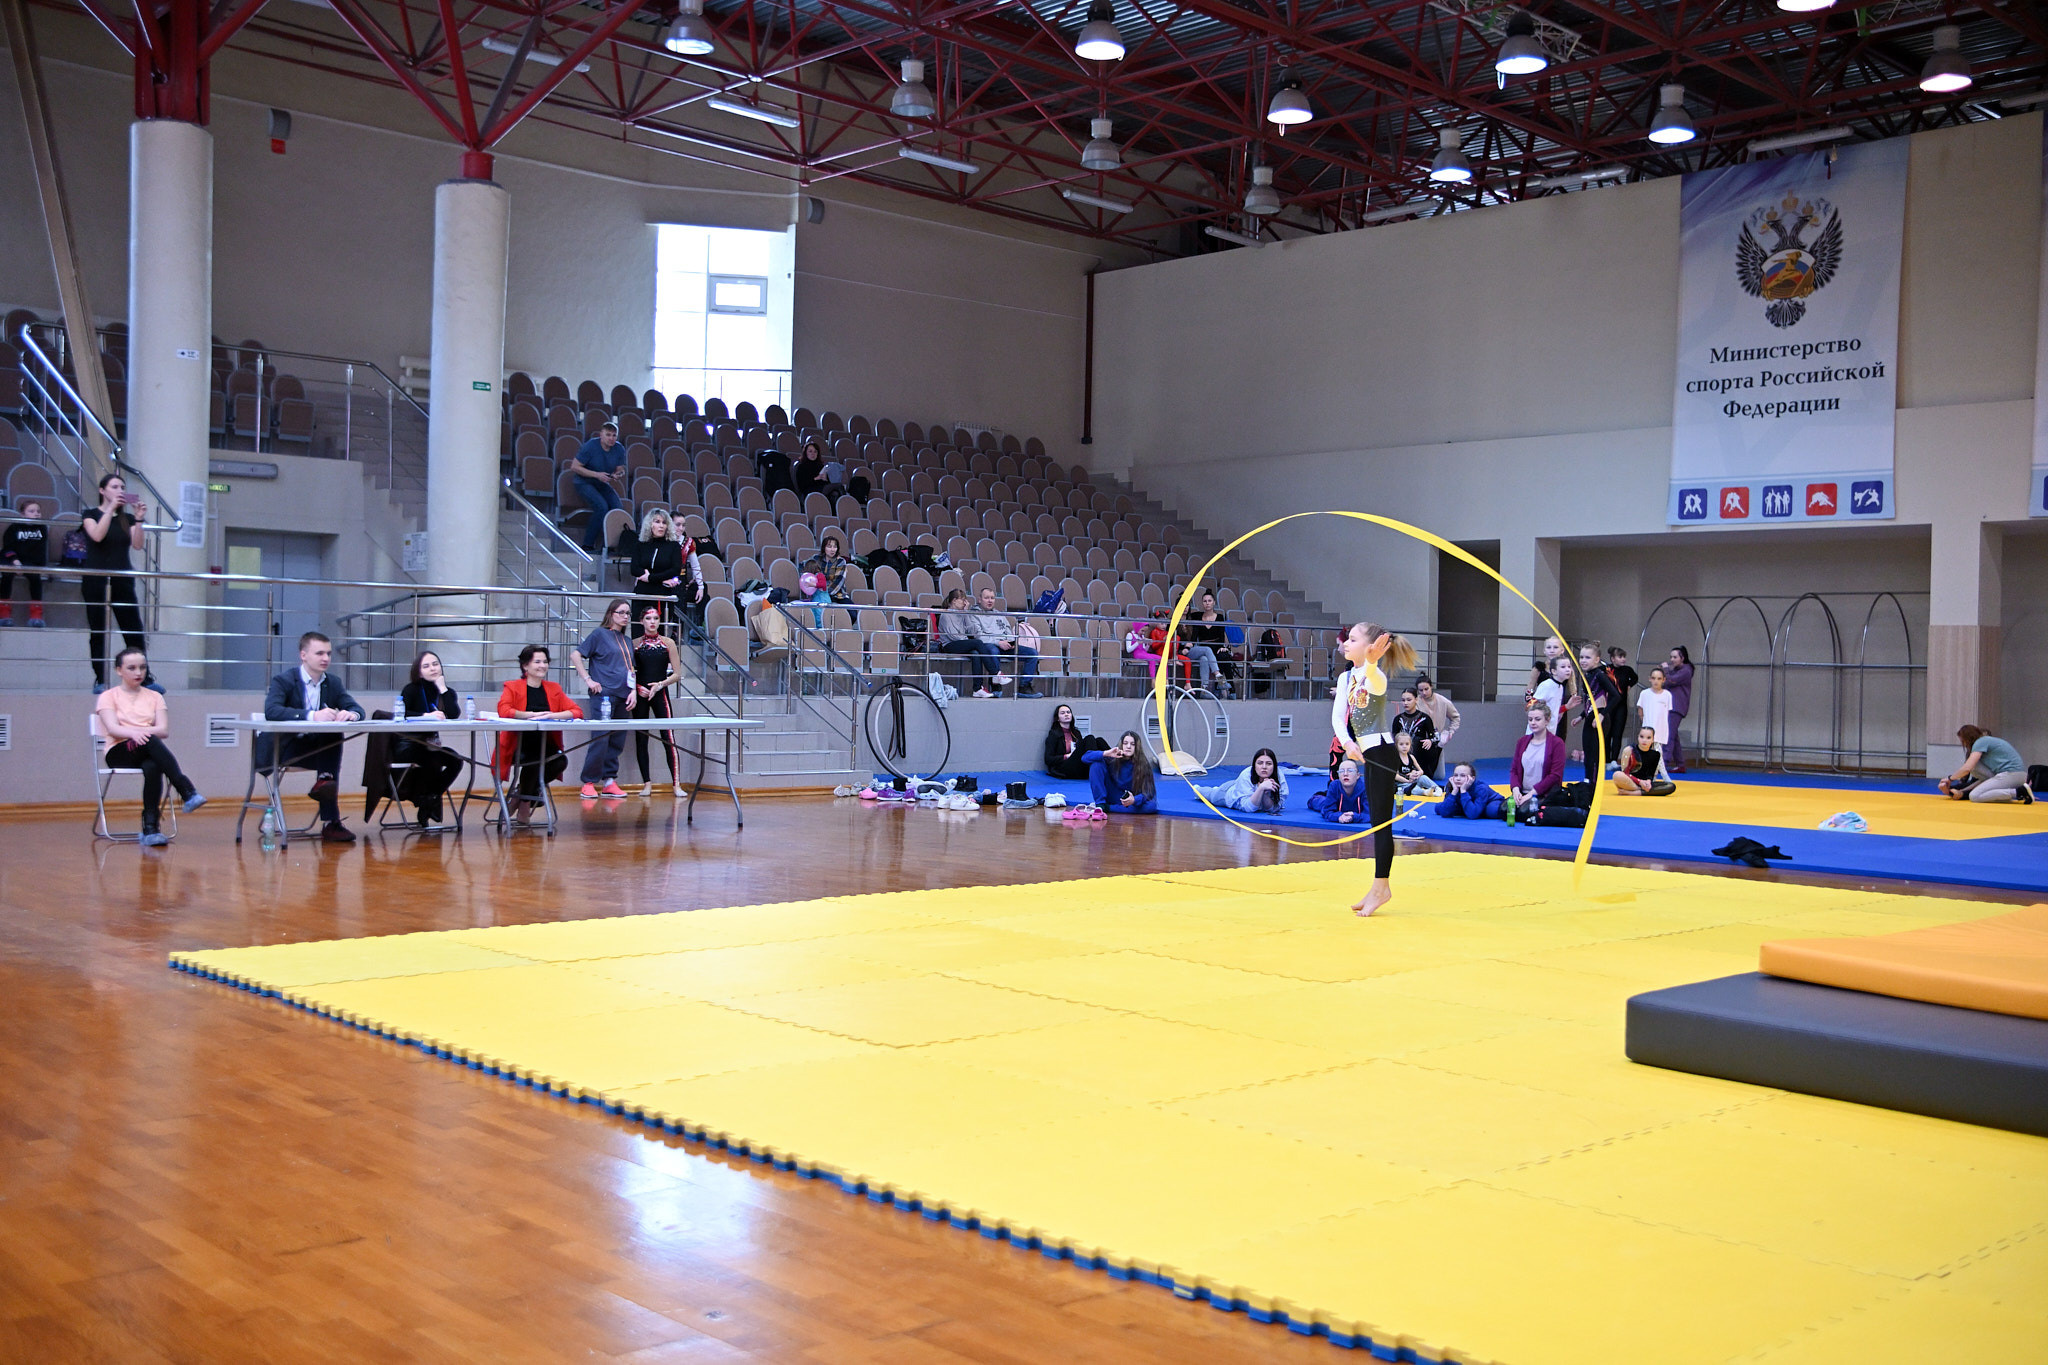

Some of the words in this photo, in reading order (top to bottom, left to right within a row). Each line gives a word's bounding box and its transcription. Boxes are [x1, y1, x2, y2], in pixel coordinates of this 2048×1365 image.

[1709, 338, 1862, 364] Министерство
[1686, 376, 1754, 394] спорта
[1759, 361, 1886, 388] Российской
[1723, 397, 1841, 419] Федерации
